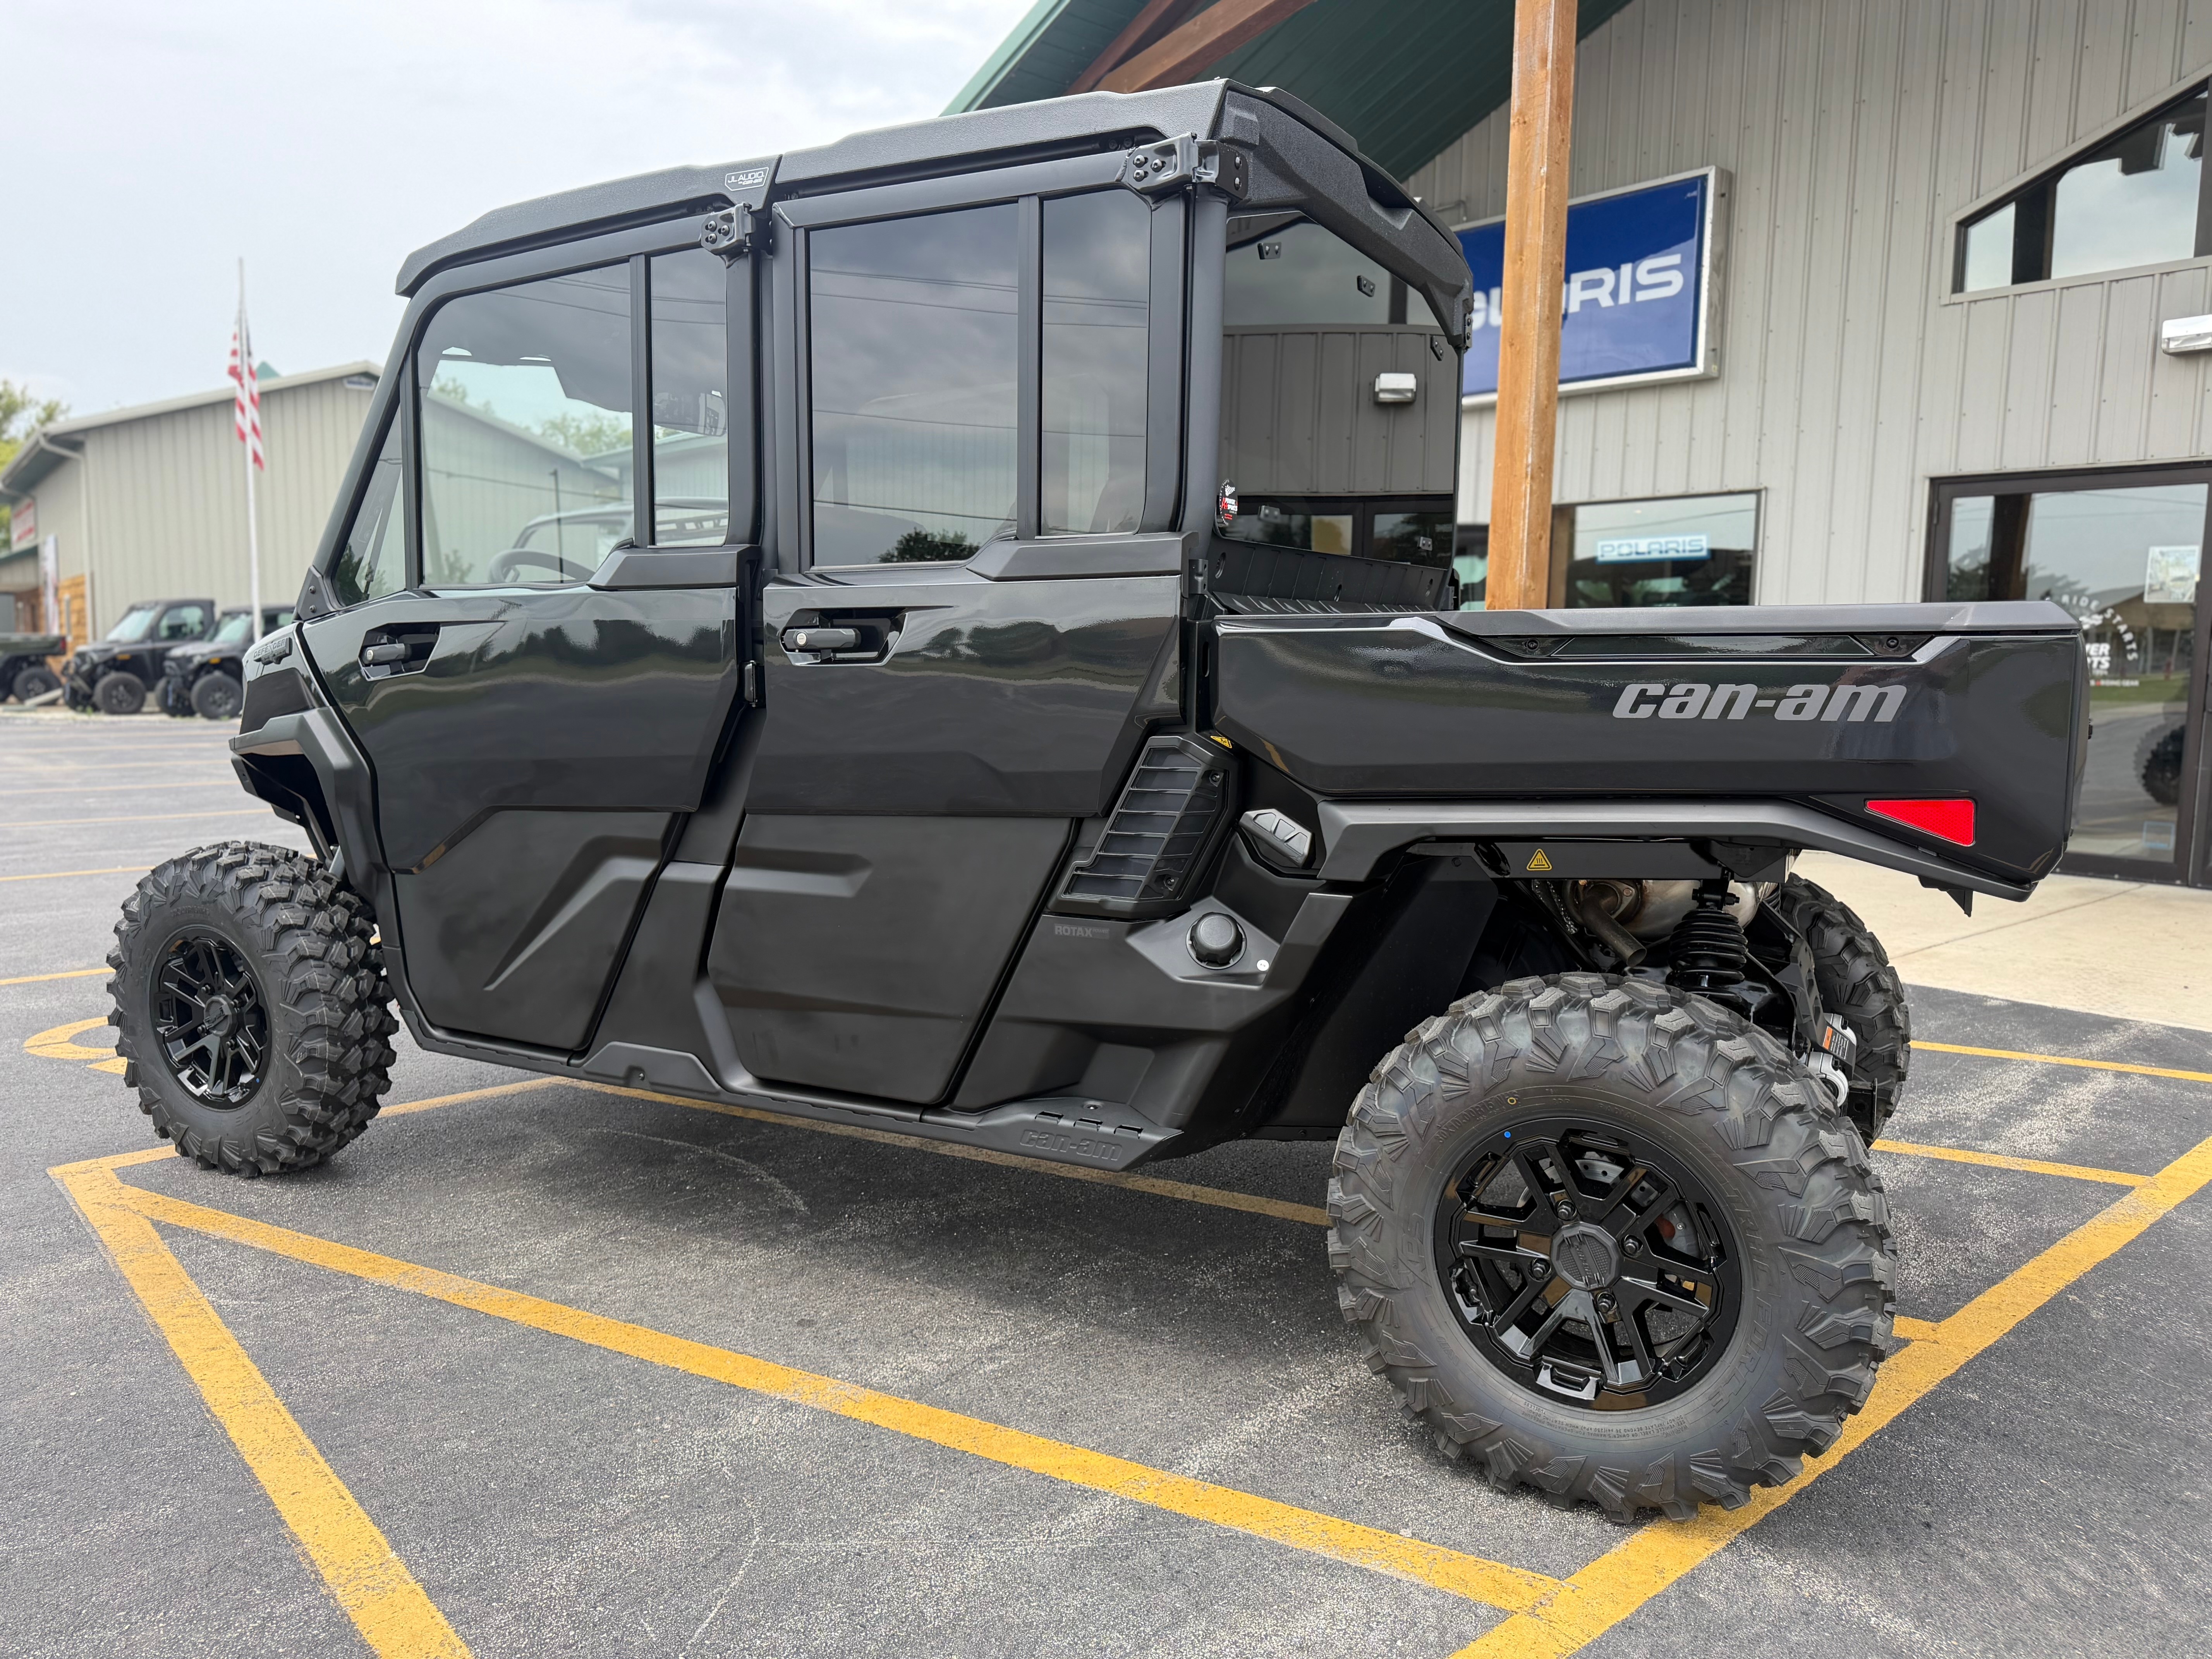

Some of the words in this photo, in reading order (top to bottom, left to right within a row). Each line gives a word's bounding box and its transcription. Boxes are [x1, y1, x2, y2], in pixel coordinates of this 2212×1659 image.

[1600, 538, 1704, 557] POLARIS
[2104, 608, 2139, 661] STARTS
[254, 638, 286, 658] DEFENDER
[1613, 684, 1906, 722] can-am
[1054, 925, 1092, 937] ROTAX
[1020, 1129, 1122, 1161] can-am
[1523, 1401, 1546, 1415] TUBELESS
[1543, 1415, 1564, 1425] SEATING
[1645, 1422, 1664, 1430] INFLATE
[1656, 1424, 1675, 1432] VEHICLE
